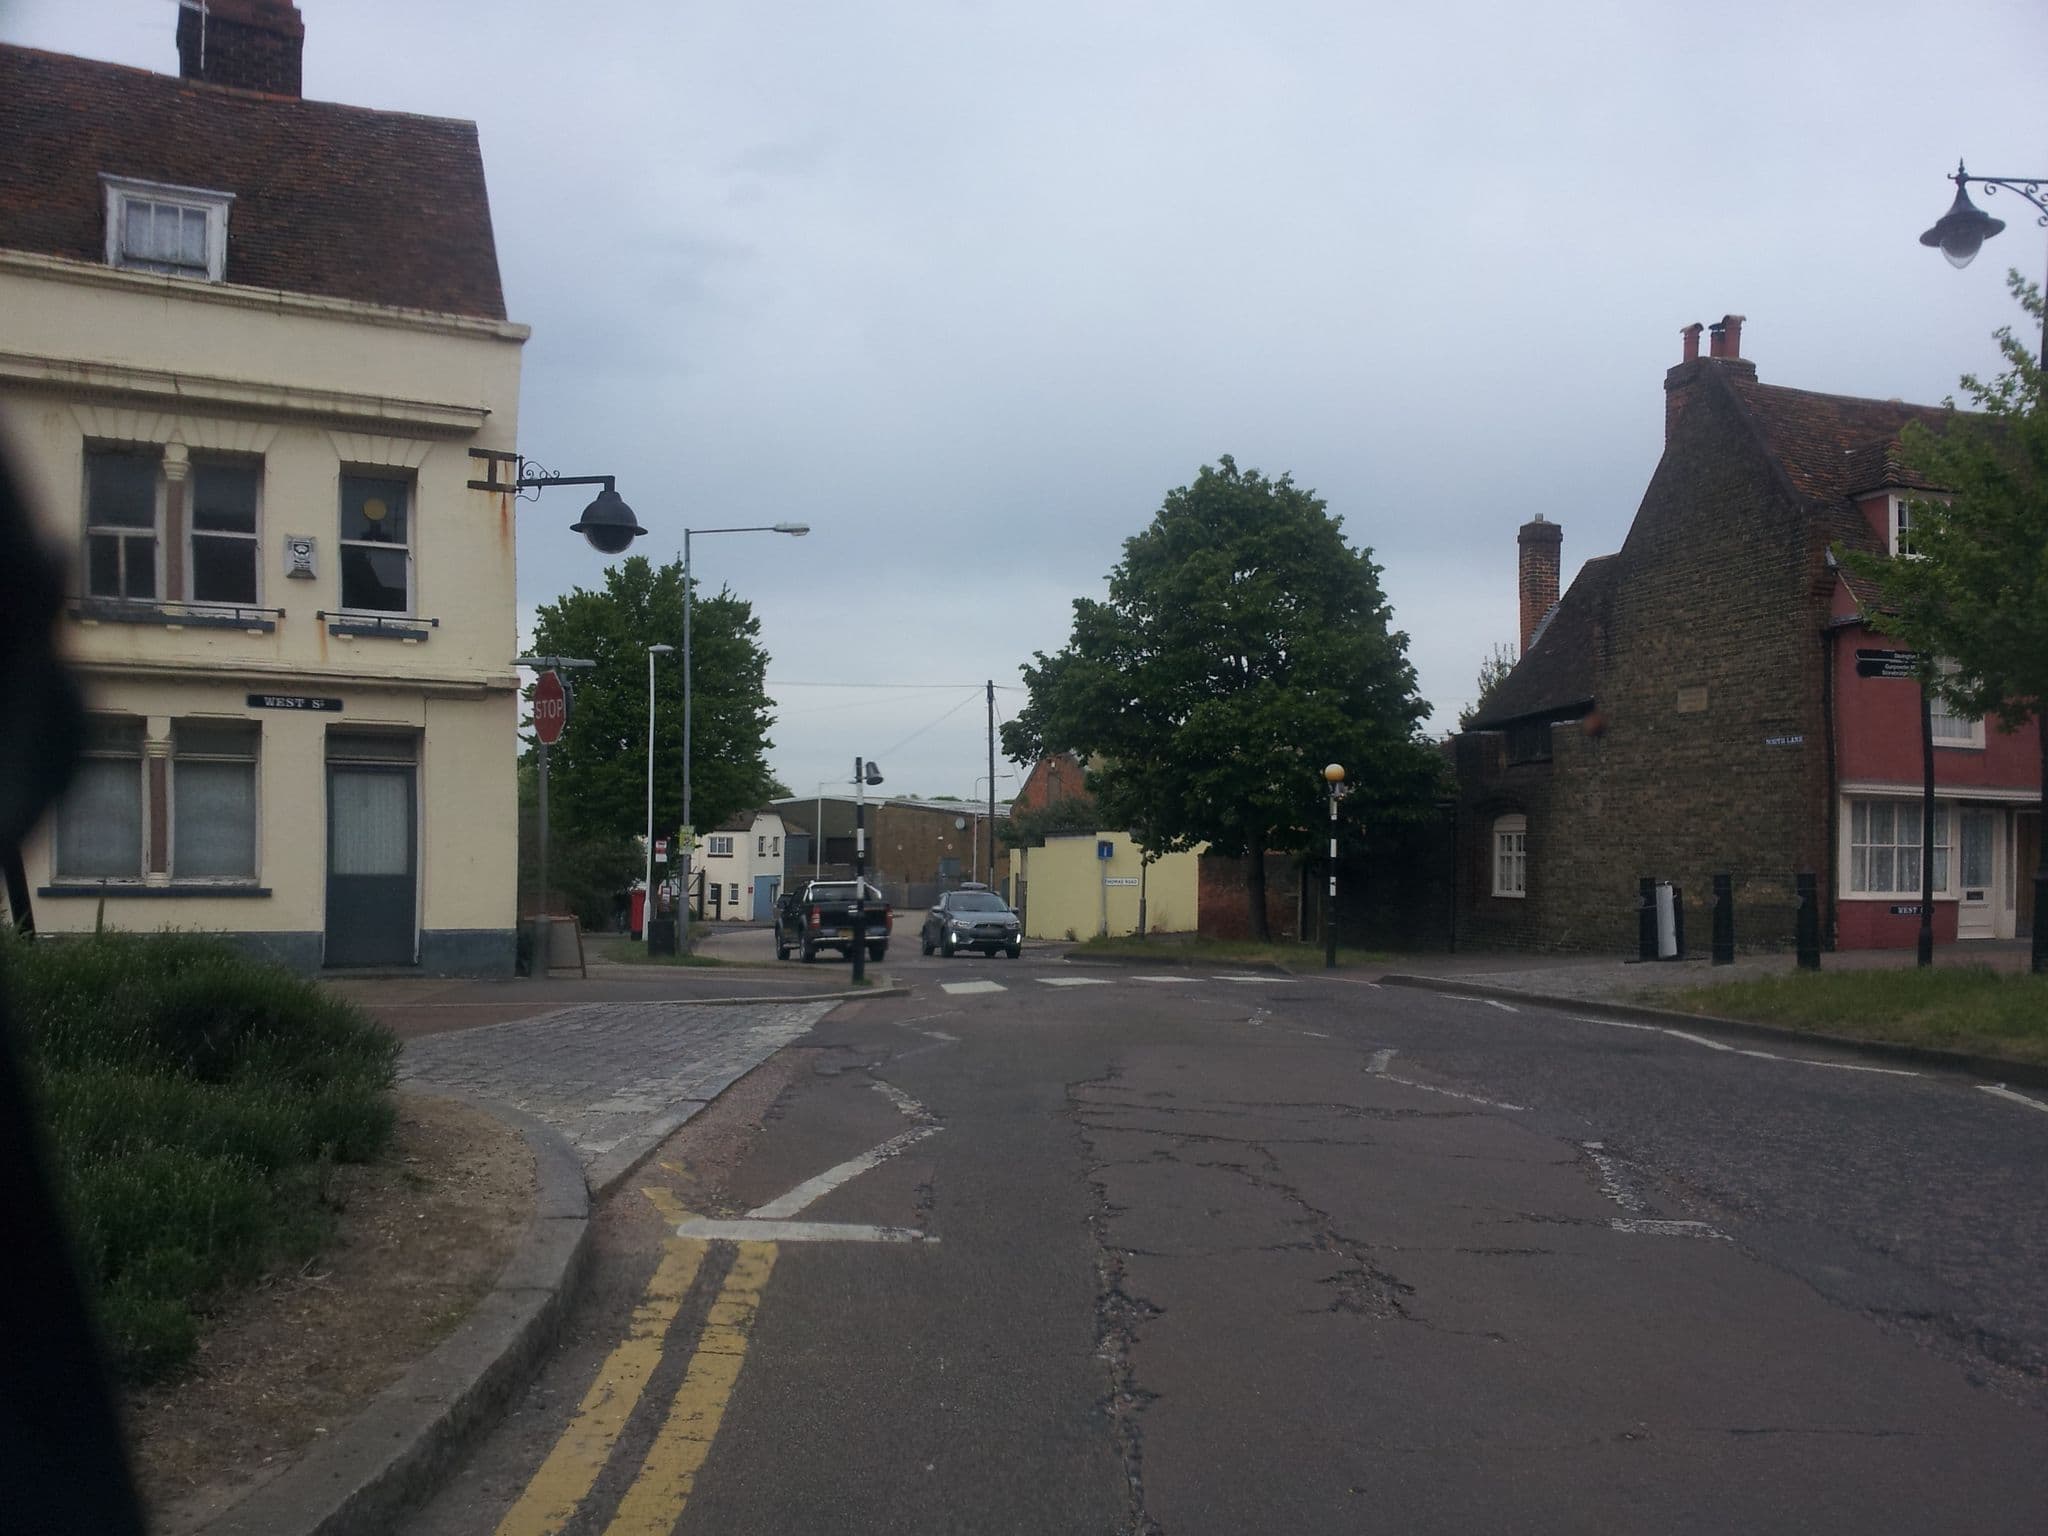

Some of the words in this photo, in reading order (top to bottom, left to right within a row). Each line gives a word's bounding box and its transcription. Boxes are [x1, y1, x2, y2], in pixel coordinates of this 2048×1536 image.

[264, 696, 305, 708] WEST
[535, 699, 563, 719] STOP
[1898, 906, 1918, 914] WEST
